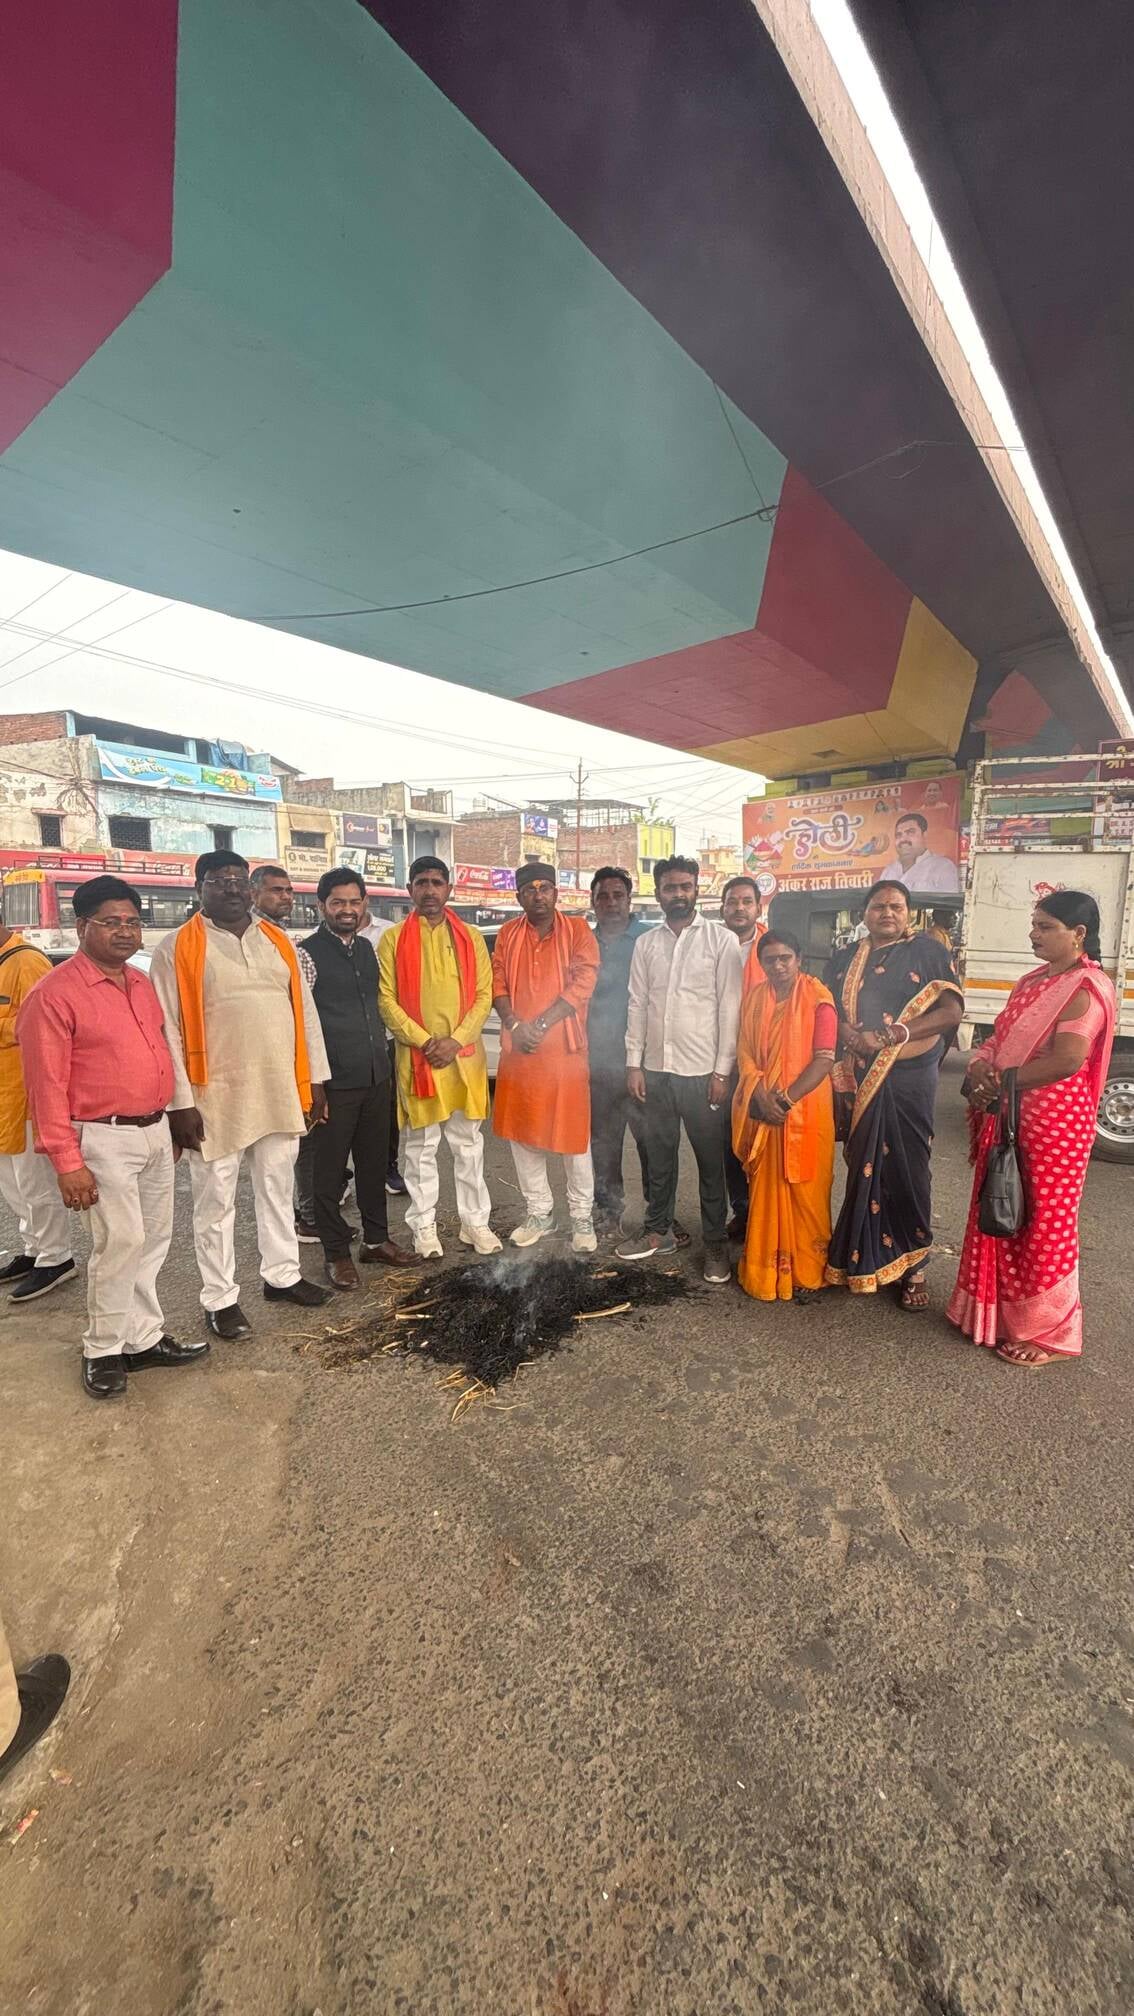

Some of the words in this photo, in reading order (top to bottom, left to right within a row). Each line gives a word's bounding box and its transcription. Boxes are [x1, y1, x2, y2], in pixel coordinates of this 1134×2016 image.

[784, 812, 864, 861] होली
[809, 876, 833, 891] राज
[834, 869, 874, 889] तिवारी
